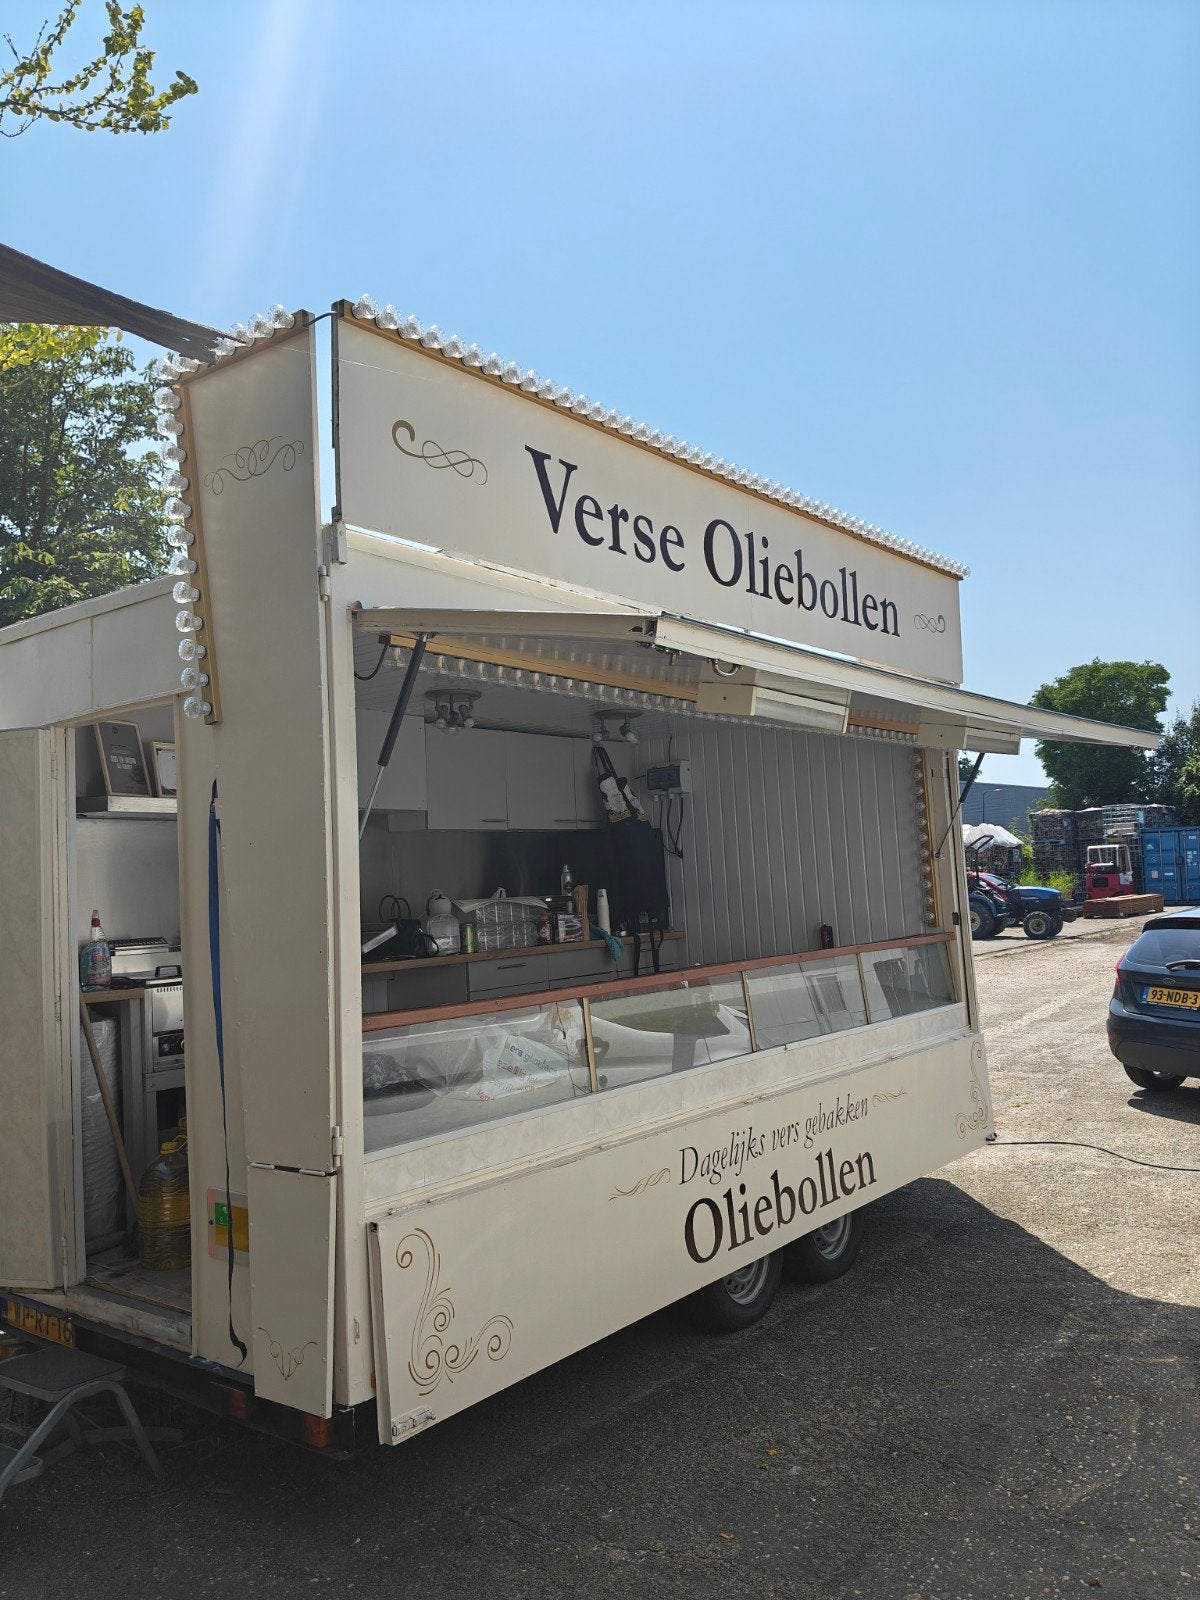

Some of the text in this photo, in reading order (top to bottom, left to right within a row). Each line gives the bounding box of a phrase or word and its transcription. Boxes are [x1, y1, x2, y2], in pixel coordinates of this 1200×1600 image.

[524, 445, 901, 637] Verse Oliebollen
[1151, 989, 1199, 1005] 93-NDB-3
[679, 1093, 868, 1185] Dagelijks vers gebakken
[684, 1148, 877, 1264] Oliebollen
